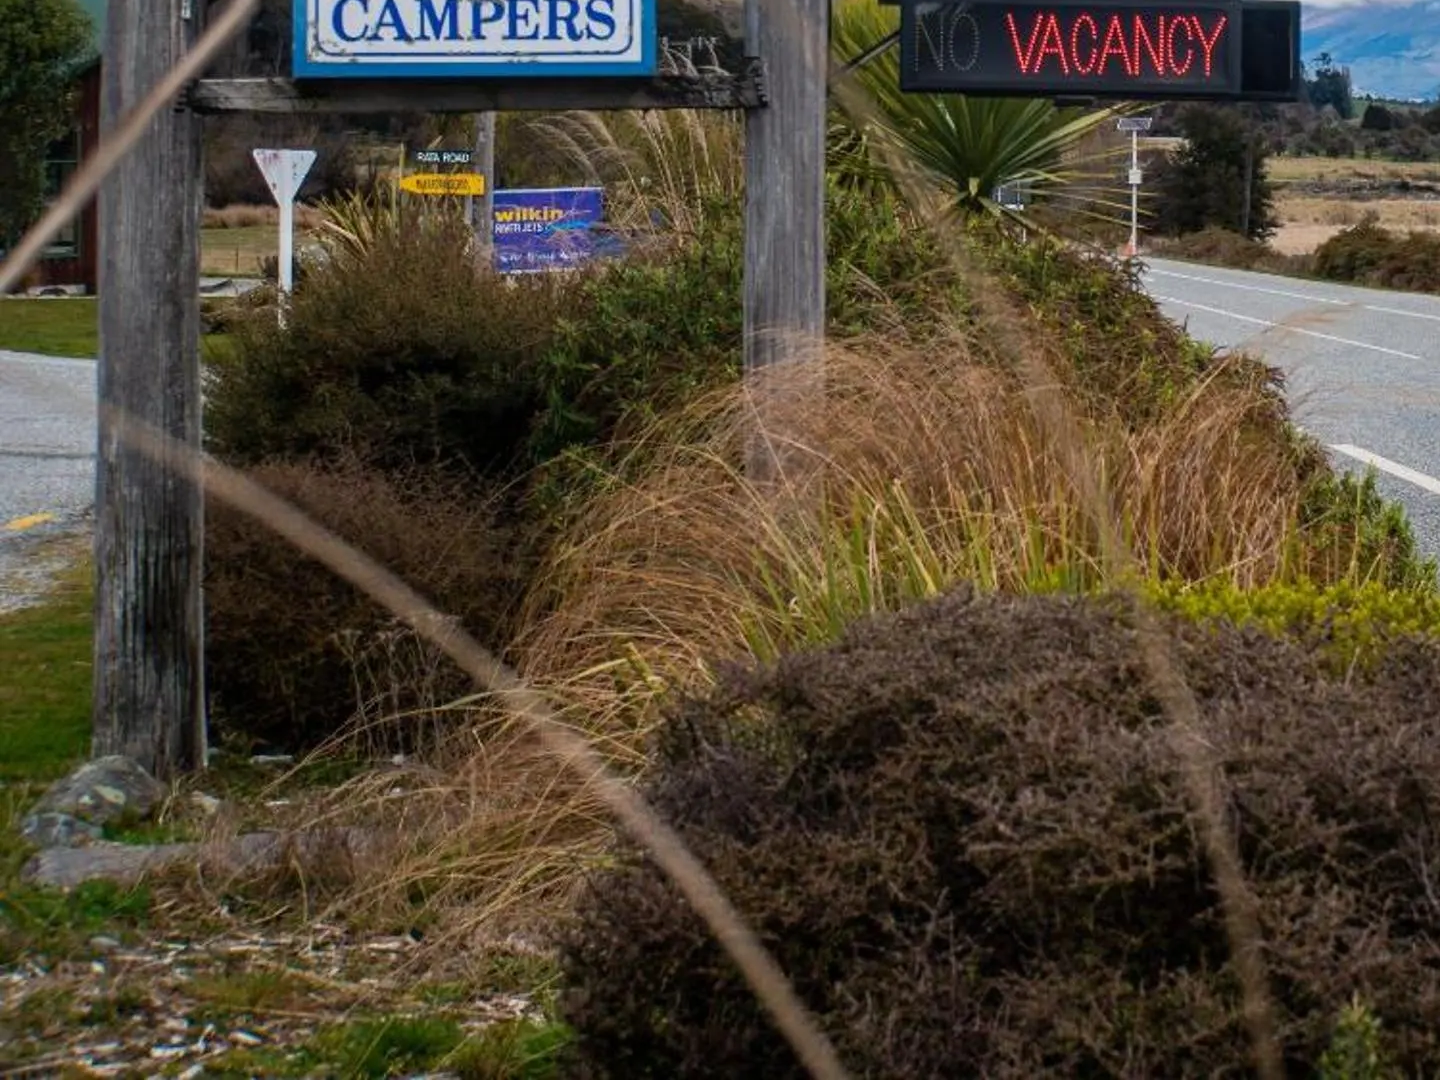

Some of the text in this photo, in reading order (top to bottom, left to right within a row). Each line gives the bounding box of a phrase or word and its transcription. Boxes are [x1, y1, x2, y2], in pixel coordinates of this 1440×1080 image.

[914, 11, 1228, 78] NO VACANCY
[442, 151, 470, 163] ROAD
[494, 207, 564, 223] wilkin
